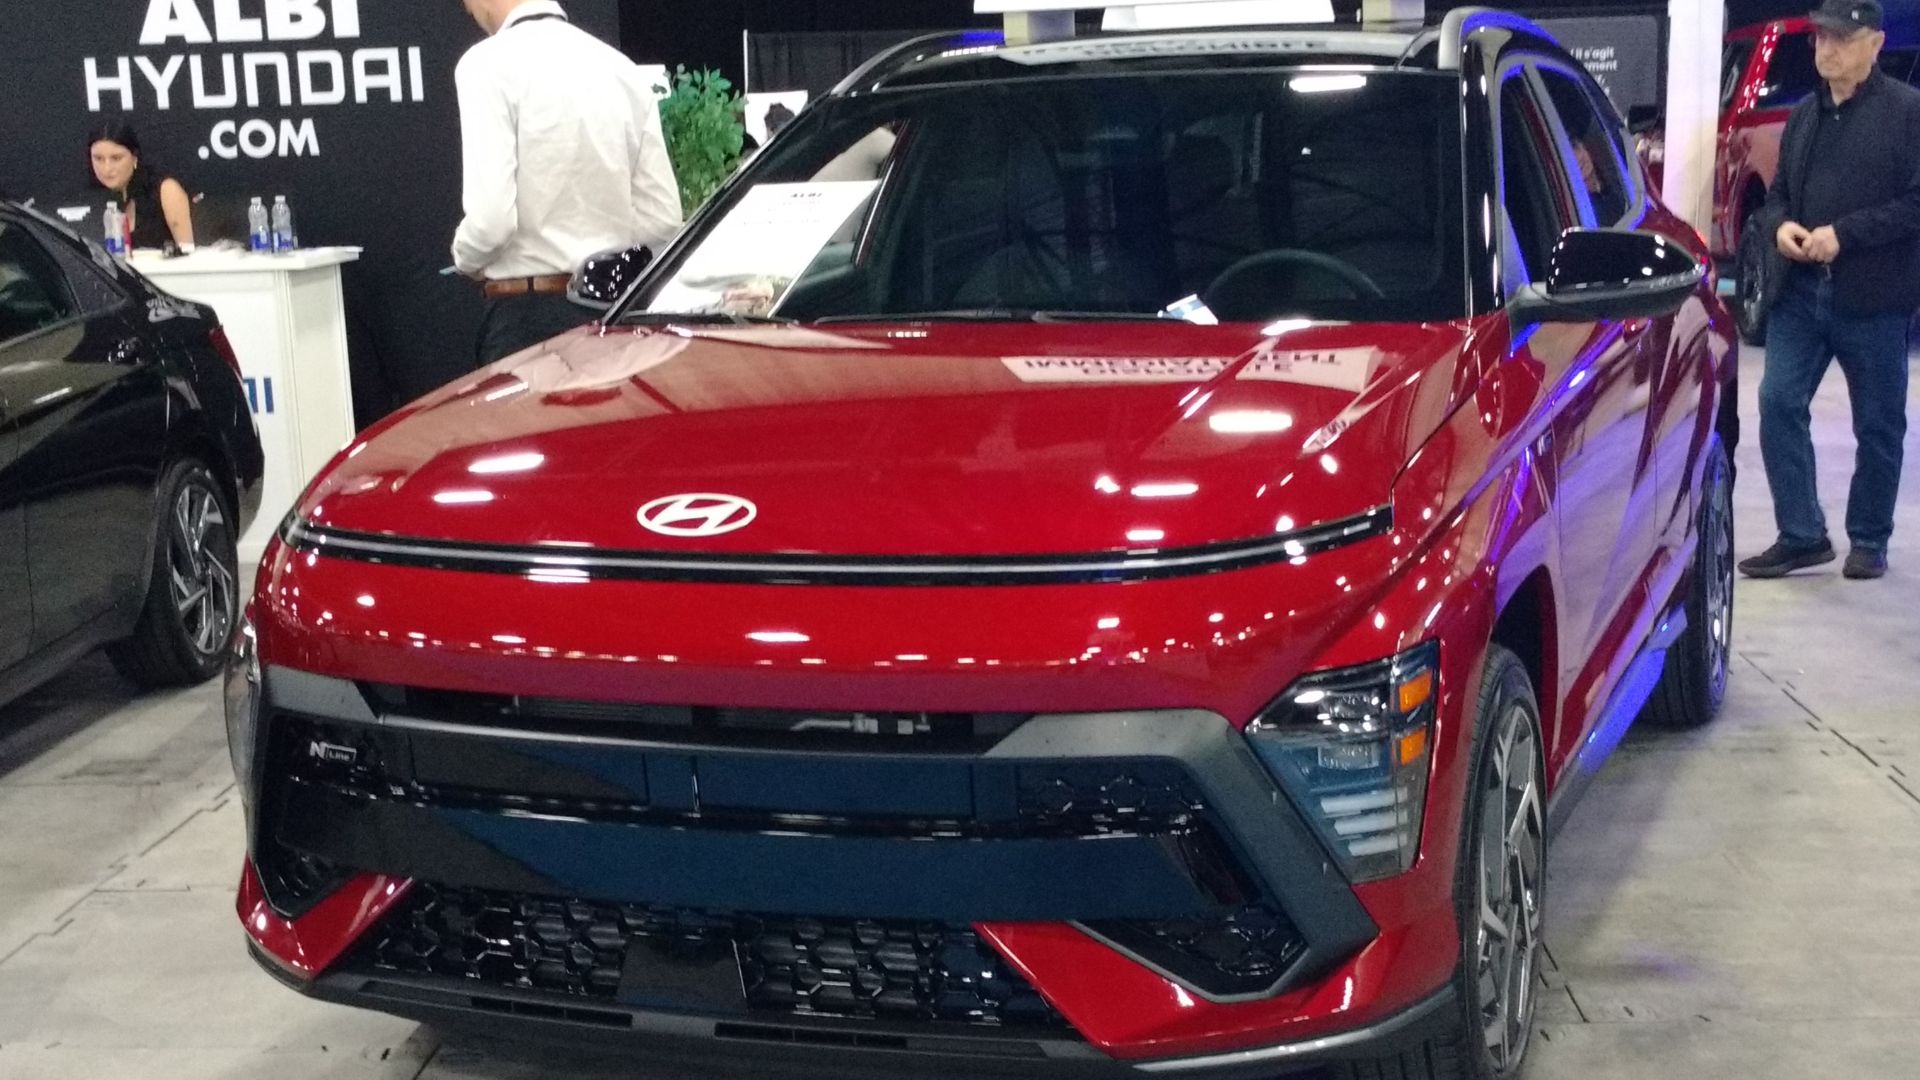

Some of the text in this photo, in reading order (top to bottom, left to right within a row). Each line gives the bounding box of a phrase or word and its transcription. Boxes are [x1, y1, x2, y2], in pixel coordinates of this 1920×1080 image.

[139, 0, 361, 45] ALBI
[84, 46, 425, 112] HYUNDAI
[198, 118, 321, 160] .COM
